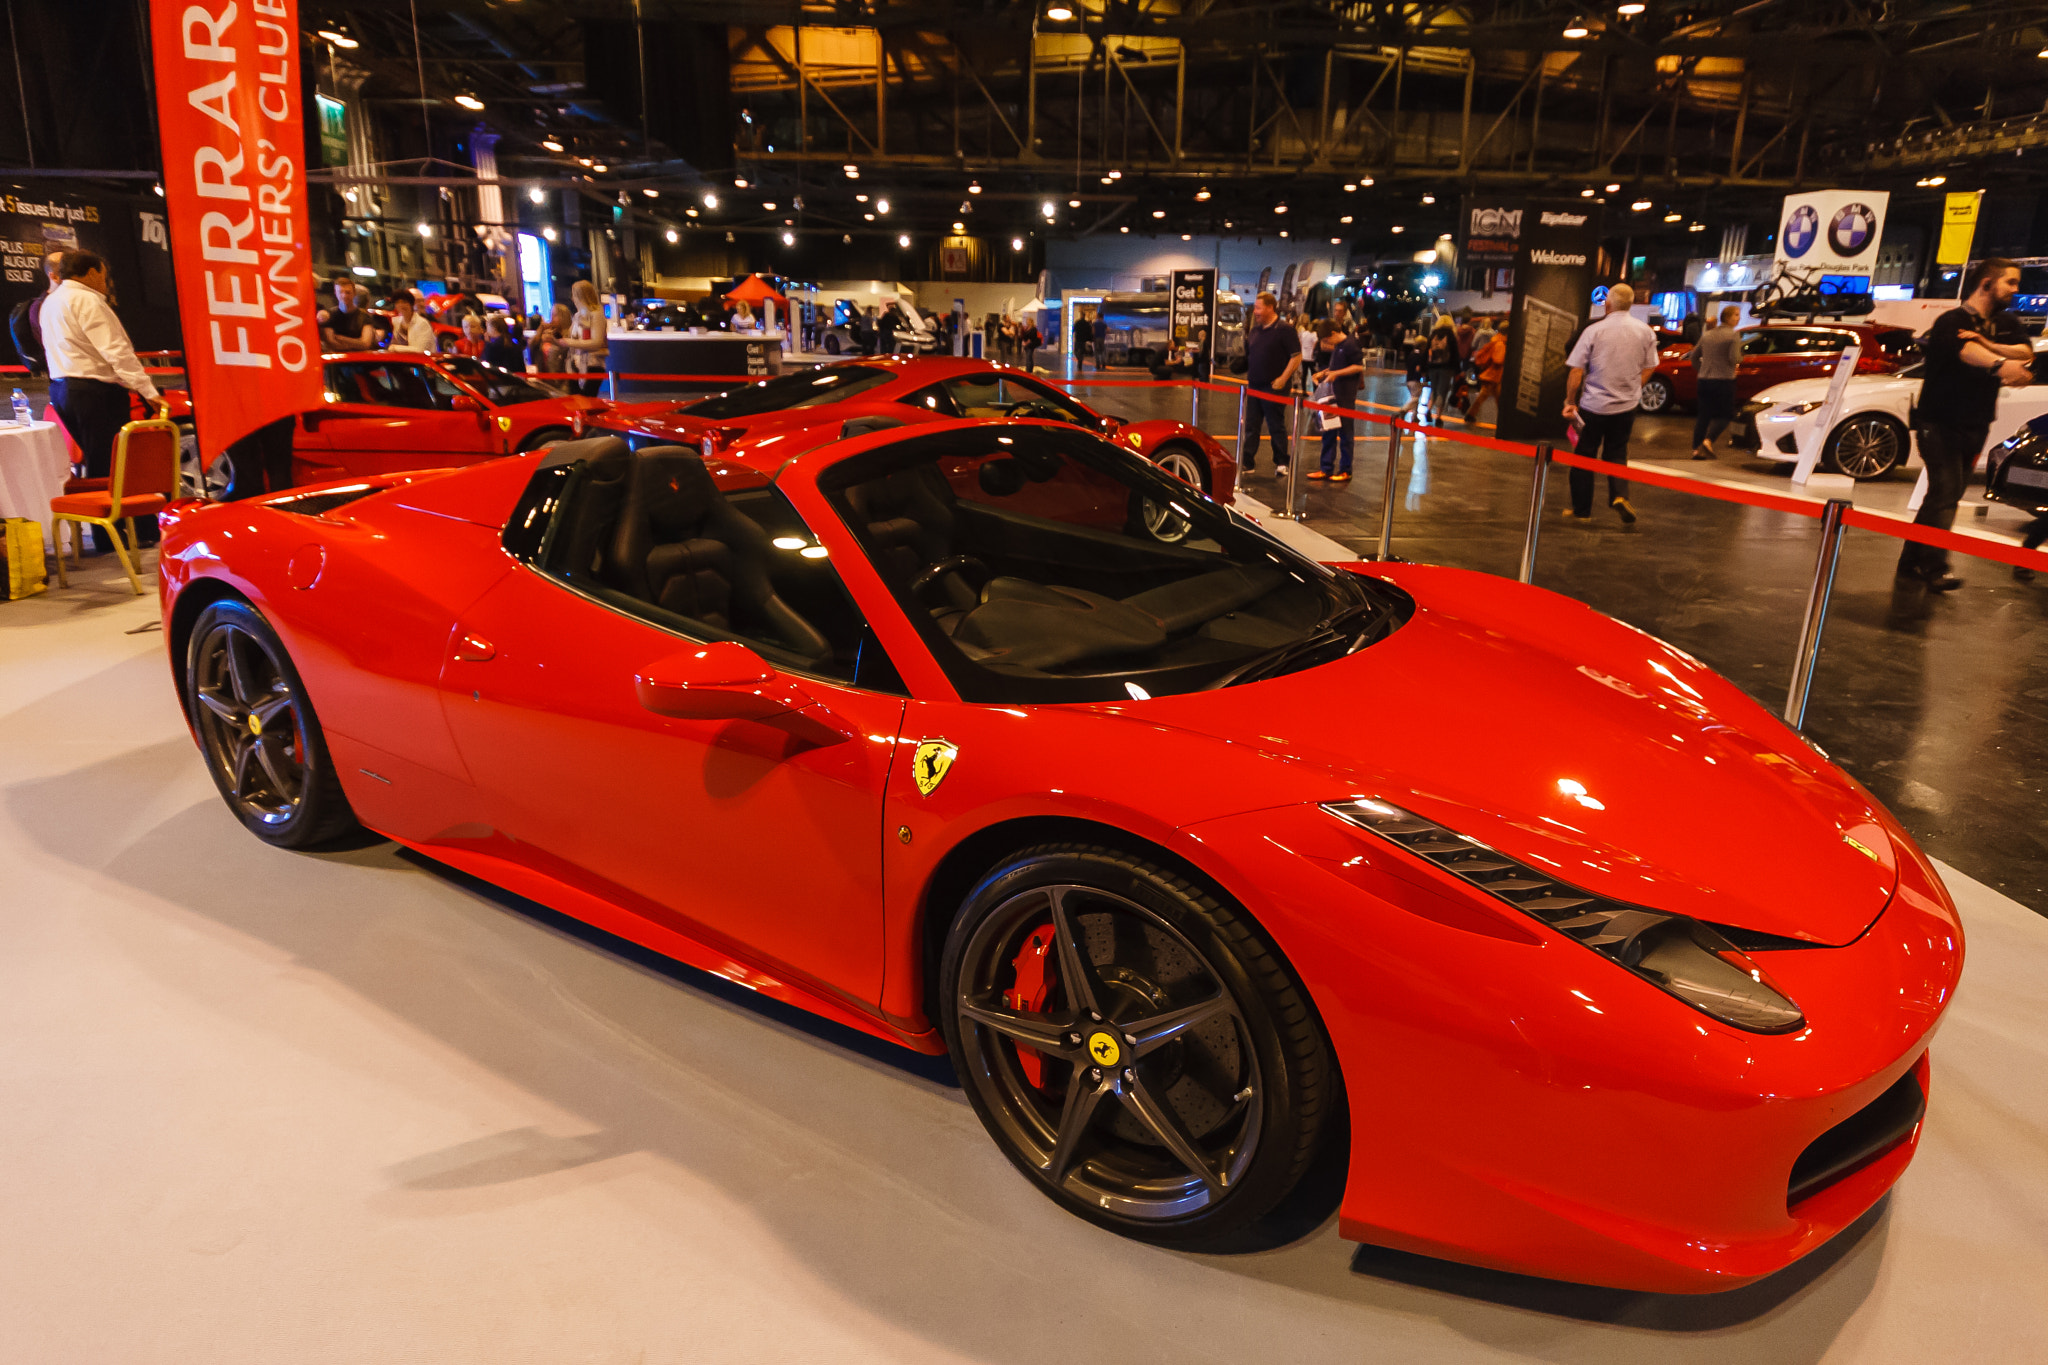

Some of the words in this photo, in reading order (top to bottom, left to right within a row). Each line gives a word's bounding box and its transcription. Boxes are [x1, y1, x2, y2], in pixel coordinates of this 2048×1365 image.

[5, 194, 16, 213] 5
[15, 197, 51, 217] issues
[49, 200, 66, 220] for
[65, 203, 86, 225] just
[0, 240, 24, 254] PLUS
[3, 255, 40, 270] AUGUST
[1530, 249, 1587, 266] Welcome
[1852, 263, 1870, 272] Park
[1176, 285, 1196, 299] Get
[1196, 285, 1204, 299] 5
[1175, 299, 1204, 312] issues
[1175, 312, 1190, 325] for
[1190, 312, 1209, 329] just
